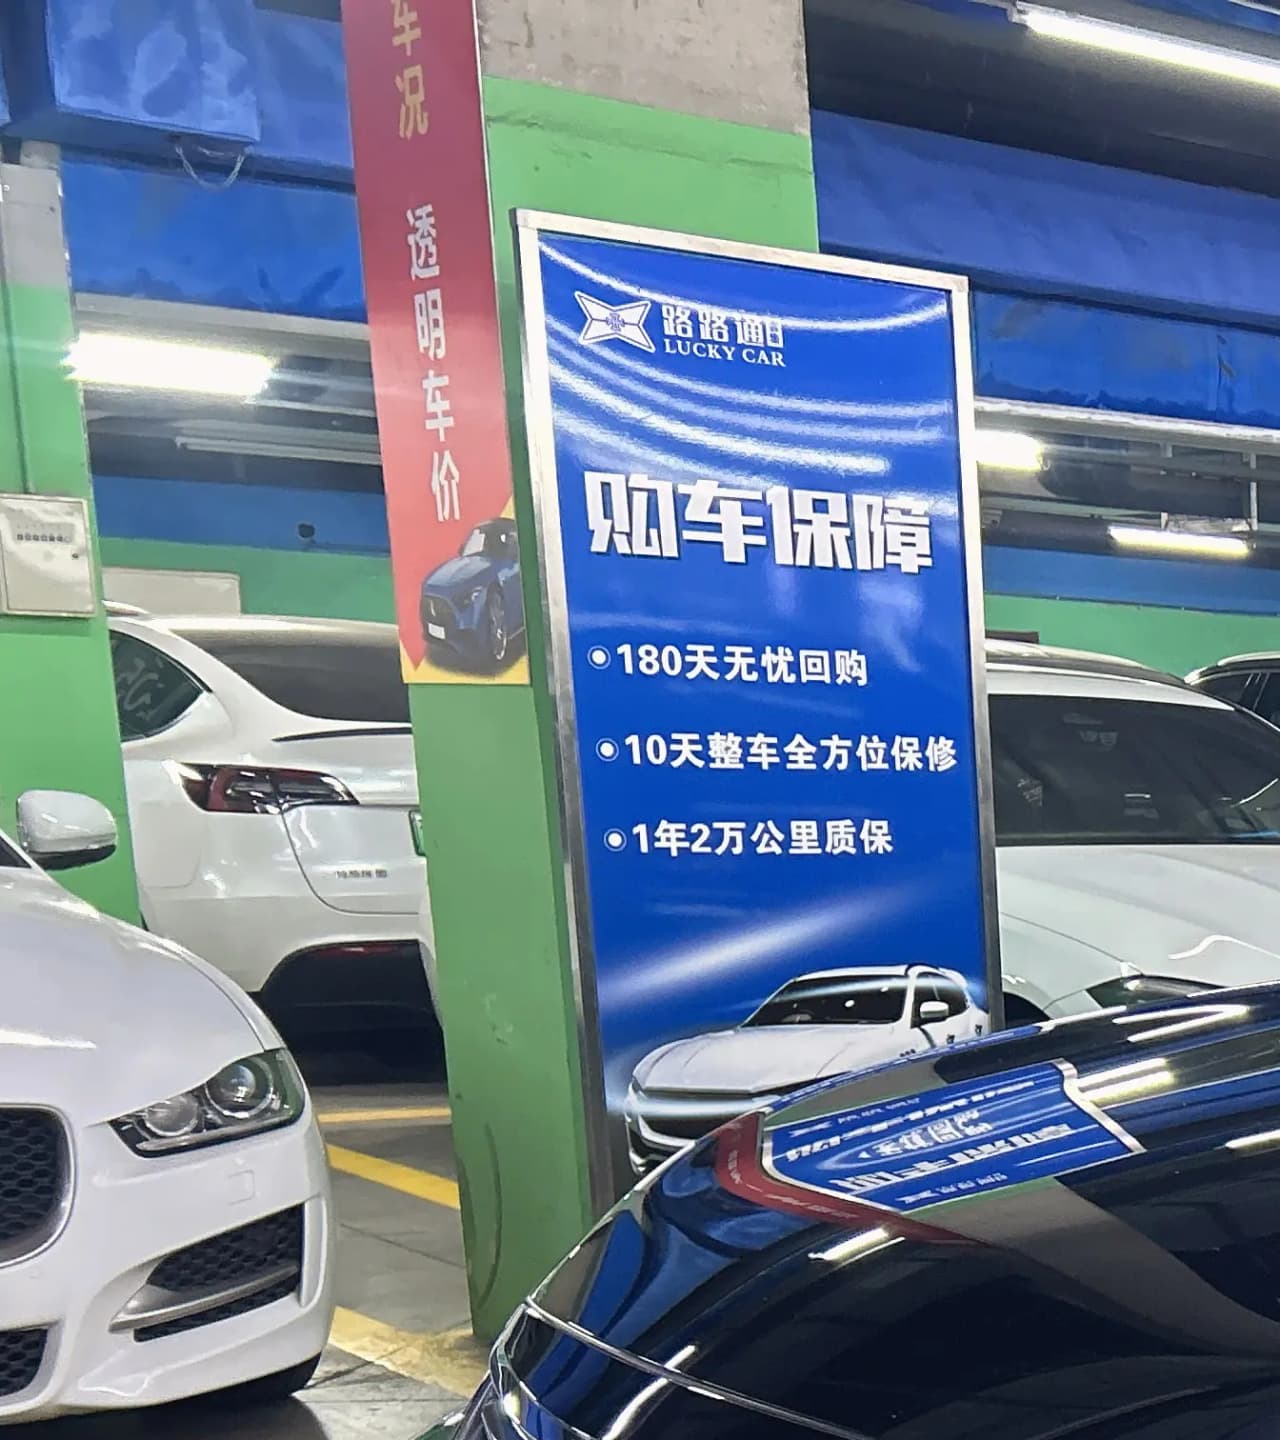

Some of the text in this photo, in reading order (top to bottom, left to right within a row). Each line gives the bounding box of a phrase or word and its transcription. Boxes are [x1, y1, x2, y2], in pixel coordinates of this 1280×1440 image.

[404, 203, 460, 523] 透明车价
[663, 338, 787, 367] LUCKY CAR
[584, 470, 933, 574] 购车保障
[615, 644, 868, 687] 180天无忧回购
[624, 732, 958, 772] 10天整车全方位保修
[632, 818, 894, 857] 1年2万公里质保
